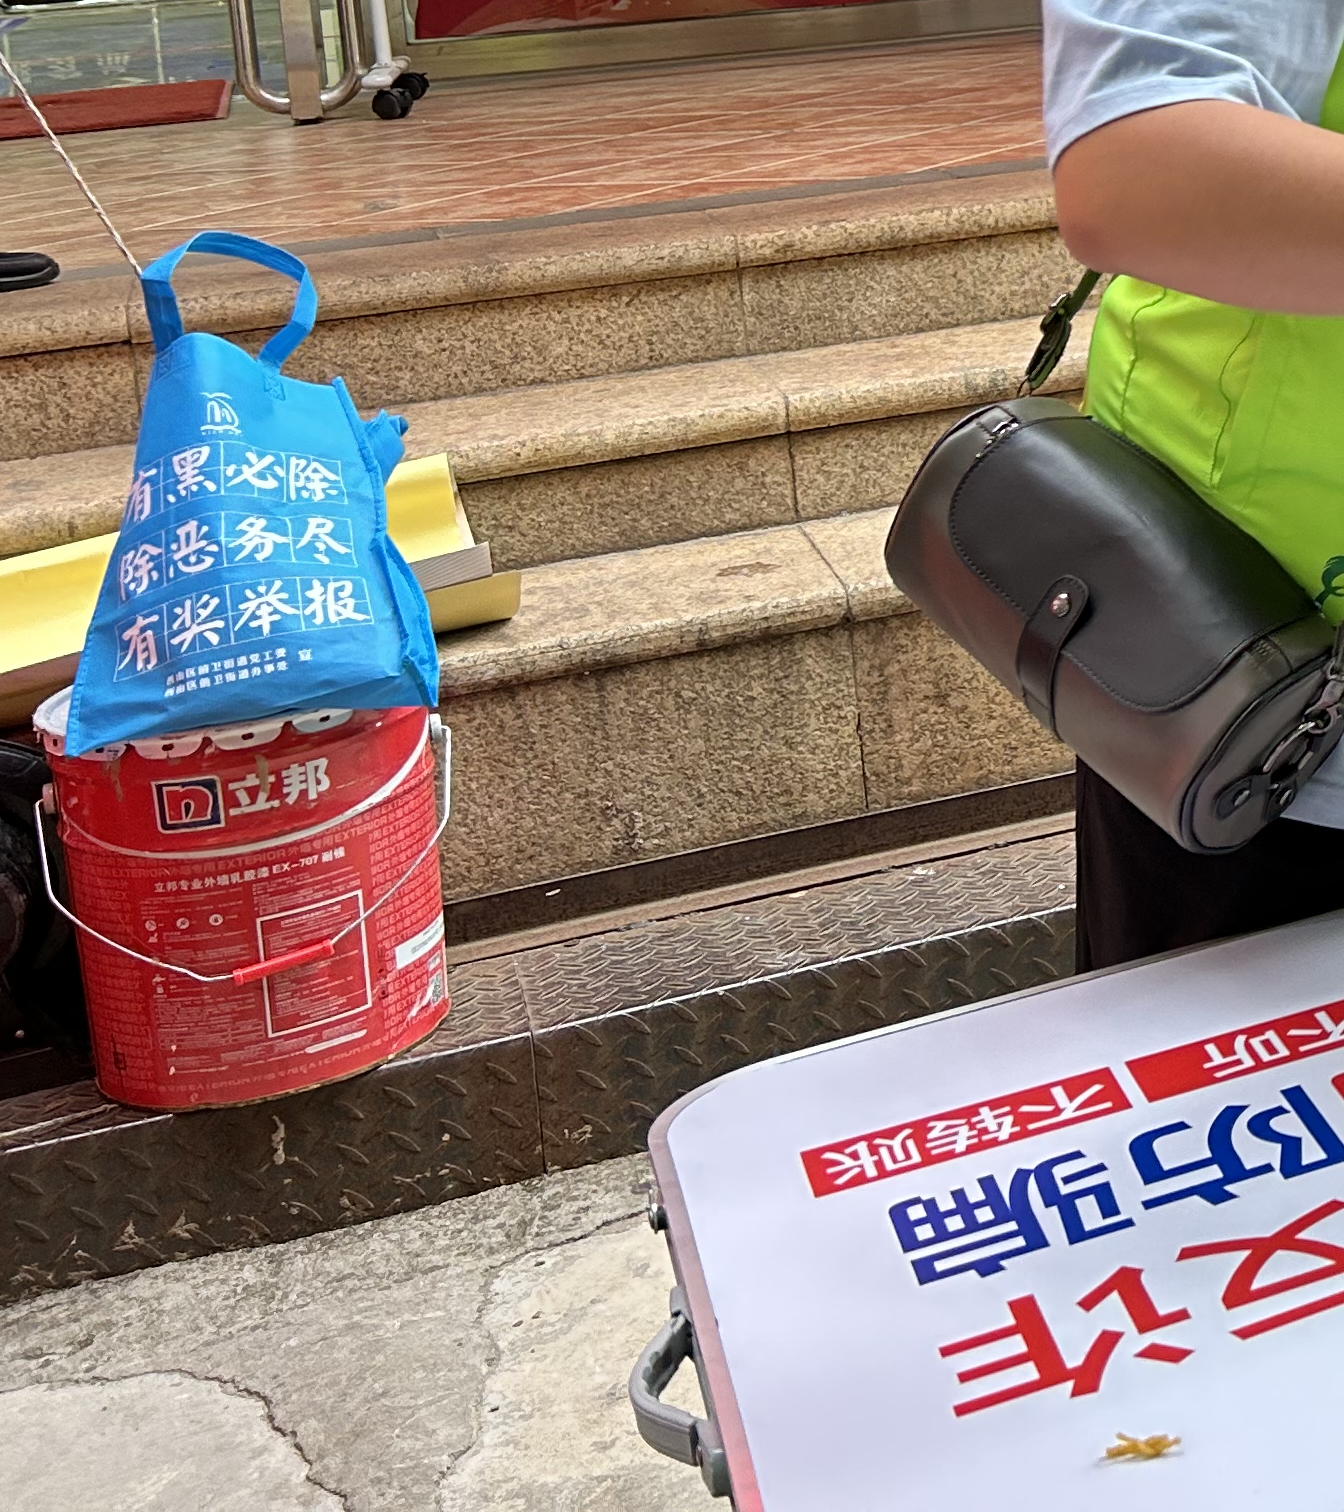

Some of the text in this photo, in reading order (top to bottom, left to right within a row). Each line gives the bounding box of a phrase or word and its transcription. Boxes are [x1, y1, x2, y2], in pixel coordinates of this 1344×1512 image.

[127, 446, 341, 523] 有黑必除
[117, 515, 353, 603] 除恶务尽
[118, 580, 370, 673] 有奖举报
[228, 758, 330, 816] 立邦
[820, 1079, 1115, 1186] 不转账
